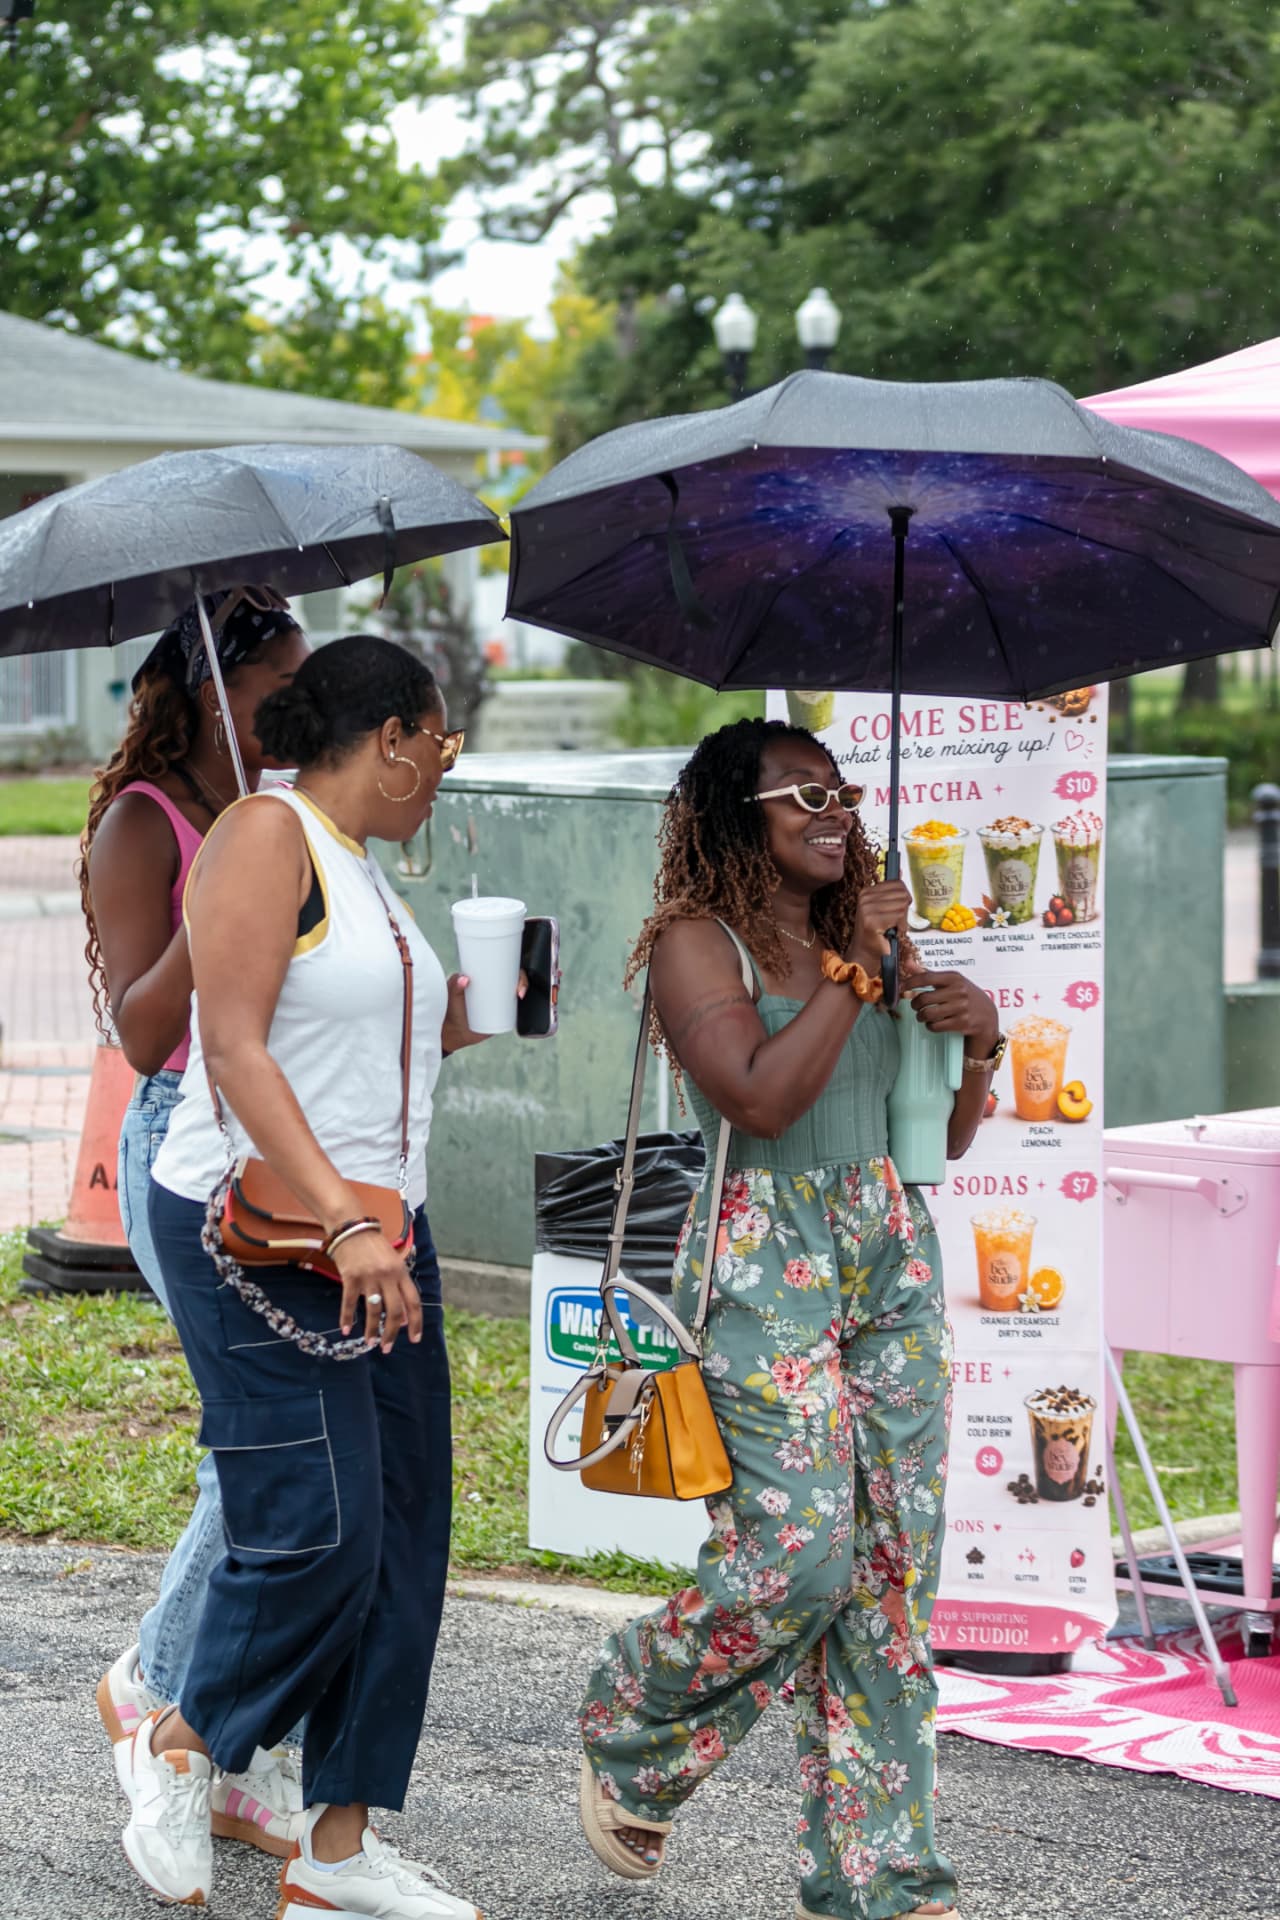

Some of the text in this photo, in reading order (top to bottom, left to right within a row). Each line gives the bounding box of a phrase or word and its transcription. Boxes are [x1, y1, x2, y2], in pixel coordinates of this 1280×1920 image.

[850, 702, 1024, 743] COME SEE
[941, 737, 1012, 764] mixing
[1018, 731, 1056, 762] up!
[1066, 777, 1091, 794] $10
[874, 780, 984, 807] MATCHA
[946, 936, 973, 945] MANGO
[982, 933, 1035, 943] MAPLE VANILLA
[924, 948, 955, 956] MATCHA
[995, 944, 1025, 953] MATCHA
[1040, 942, 1082, 951] STRAWBERRY
[1076, 986, 1093, 1003] $6
[1028, 1126, 1054, 1135] PEACH
[1021, 1138, 1063, 1148] LEMONADE
[89, 1162, 117, 1191] A
[952, 1175, 1029, 1196] SODAS
[1072, 1177, 1091, 1195] $7
[980, 1316, 1061, 1326] ORANGE CREAMSICLE
[998, 1329, 1042, 1338] DIRTY SODA
[967, 1414, 1013, 1425] RUM RAISIN
[967, 1428, 1012, 1438] COLD BREW
[981, 1453, 998, 1469] $8
[936, 1611, 1029, 1625] FOR SUPPORTING
[956, 1625, 1030, 1646] STUDIO!
